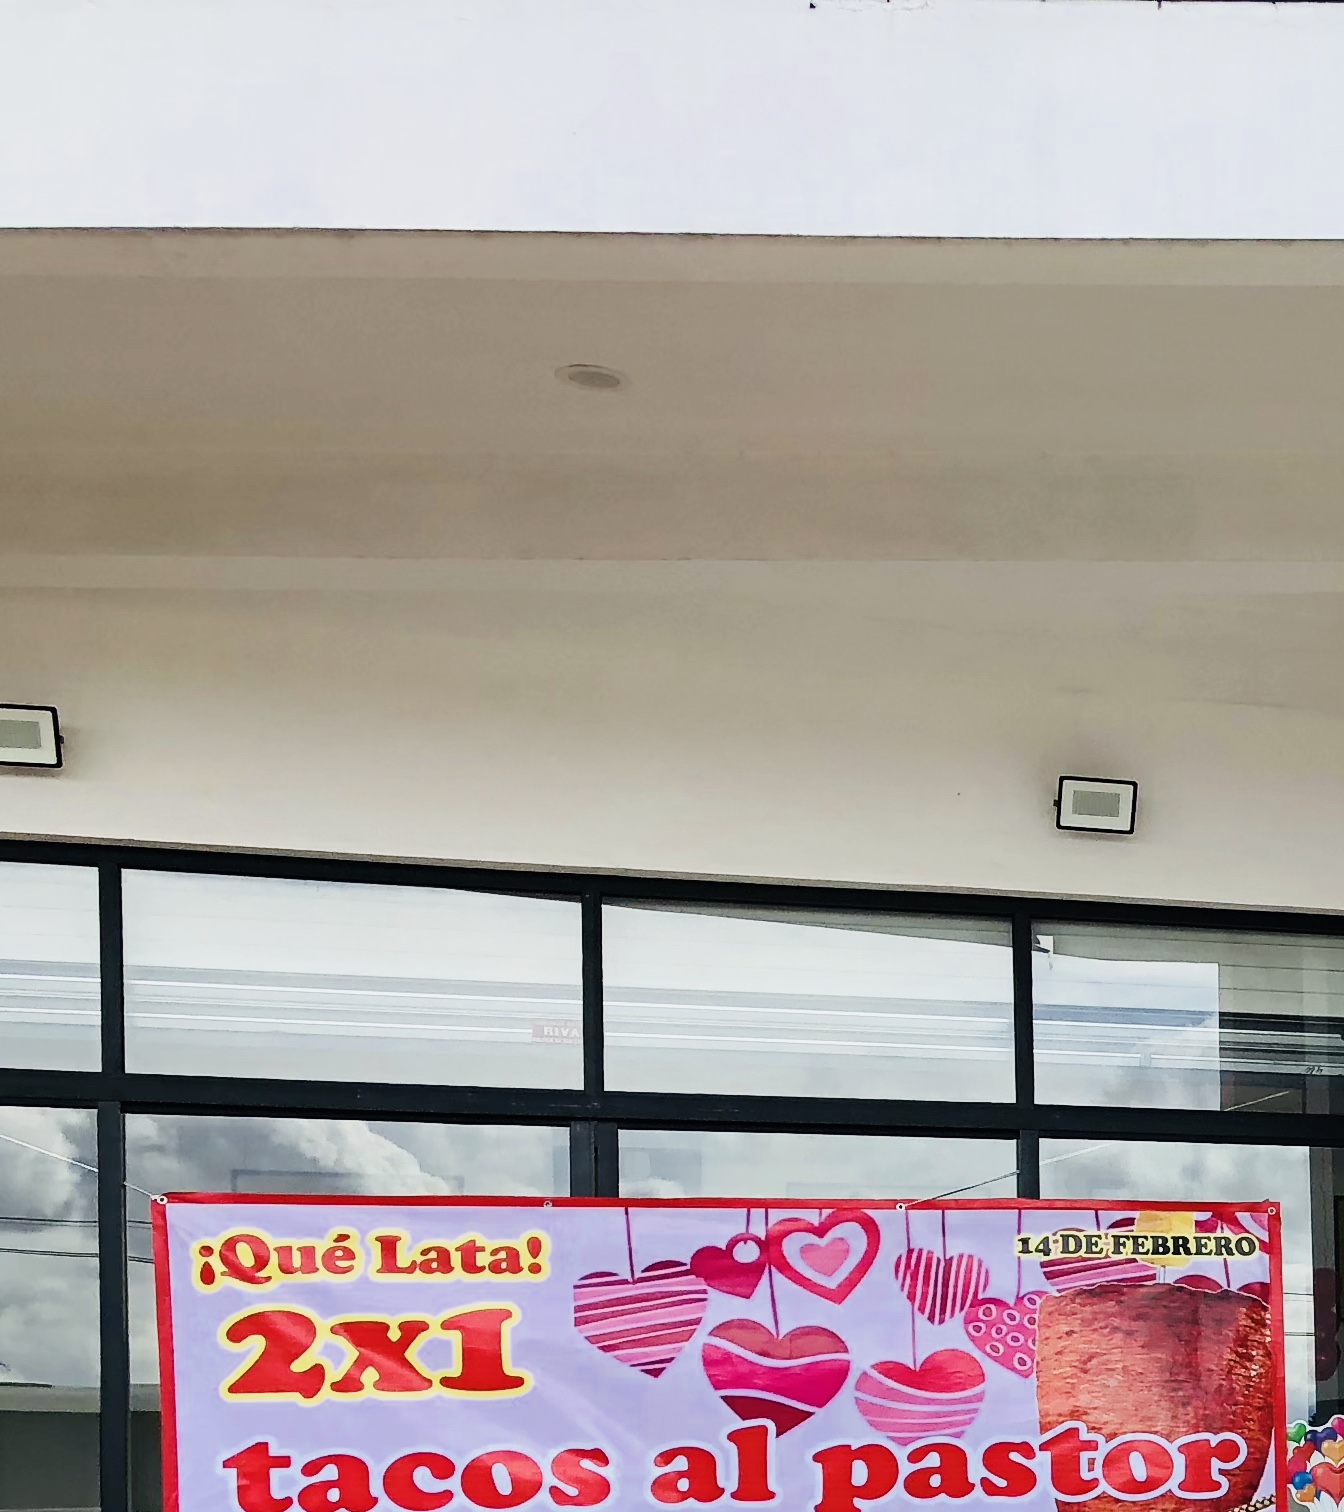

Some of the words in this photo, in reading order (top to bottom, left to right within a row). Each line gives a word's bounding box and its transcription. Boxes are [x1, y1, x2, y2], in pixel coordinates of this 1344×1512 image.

[198, 1232, 356, 1286] ¡Qué
[375, 1234, 542, 1276] Lata!
[1017, 1235, 1052, 1257] 14
[1059, 1233, 1104, 1255] DE
[1111, 1234, 1257, 1257] FEBRERO
[650, 1425, 777, 1504] al
